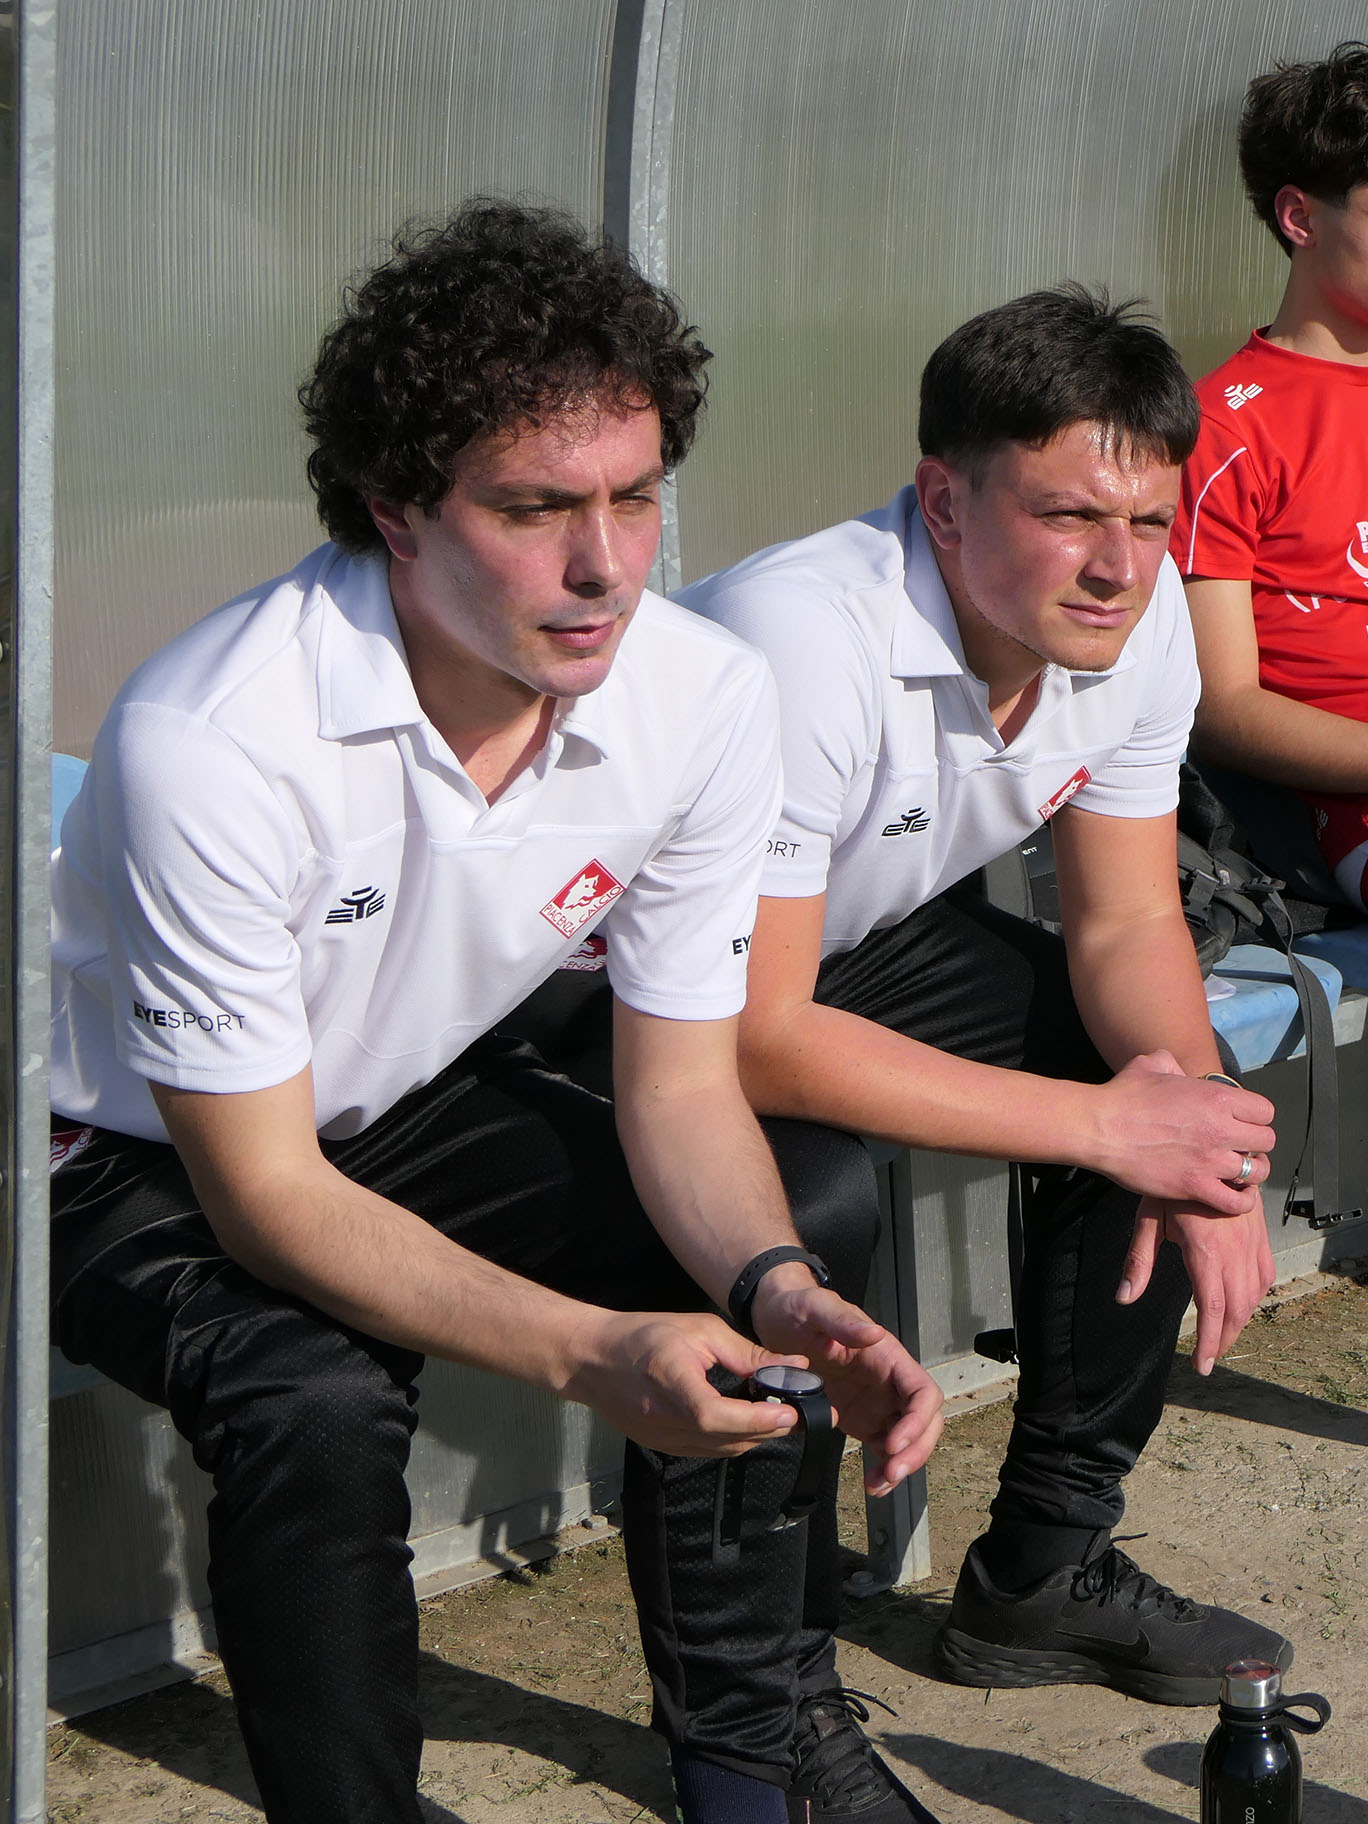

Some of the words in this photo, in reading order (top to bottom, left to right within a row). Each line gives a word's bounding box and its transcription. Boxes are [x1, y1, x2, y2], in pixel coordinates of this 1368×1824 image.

[543, 904, 576, 935] PIACENZA
[578, 886, 621, 923] CALCIO
[133, 1000, 245, 1032] EYESPORT
